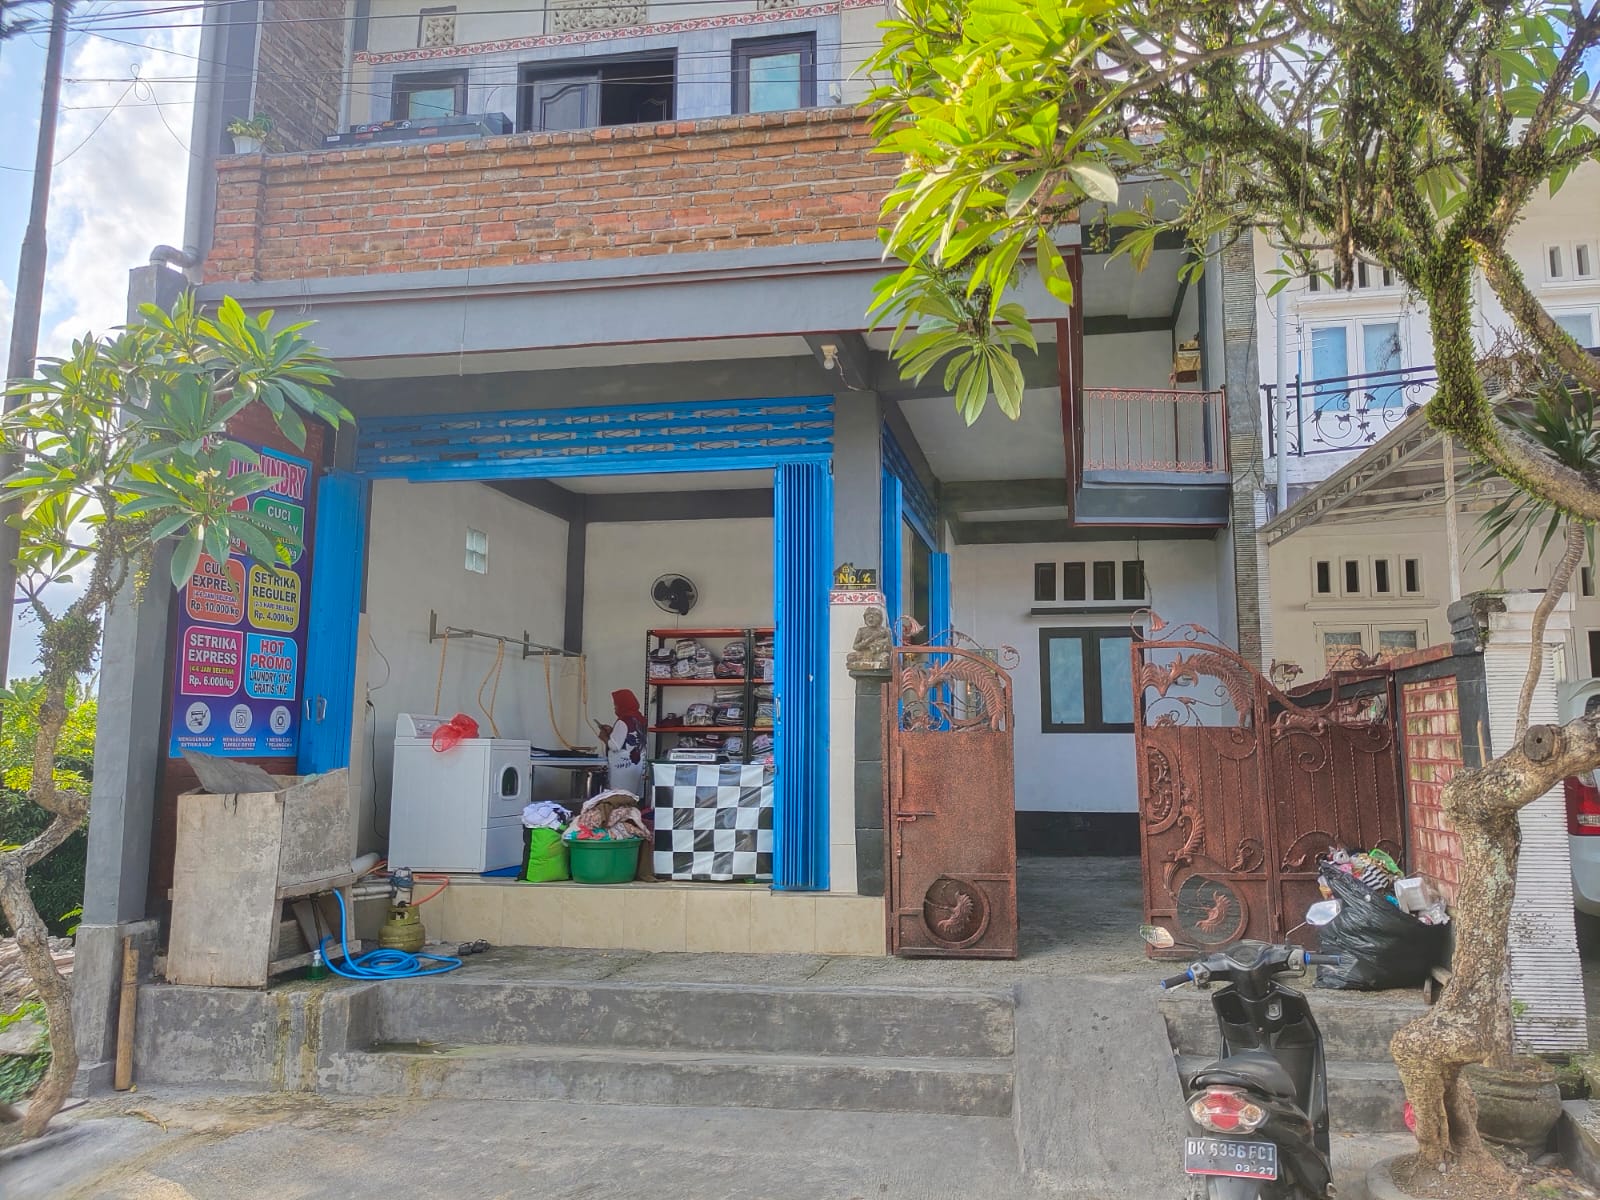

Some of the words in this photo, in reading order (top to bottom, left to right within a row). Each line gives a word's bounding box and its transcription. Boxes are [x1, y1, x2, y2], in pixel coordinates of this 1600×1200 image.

[268, 506, 290, 522] CUCI
[254, 571, 296, 590] SETRIKA
[839, 573, 860, 584] No.
[252, 586, 297, 603] REGULER
[190, 600, 202, 610] Rp.
[254, 610, 264, 620] Rp.
[190, 634, 237, 650] SETRIKA
[260, 638, 284, 654] HOT
[188, 650, 238, 666] EXPRESS
[250, 654, 292, 670] PROMO
[188, 675, 202, 687] Rp.
[250, 670, 276, 682] LAUNDRY
[1188, 1141, 1205, 1156] DK
